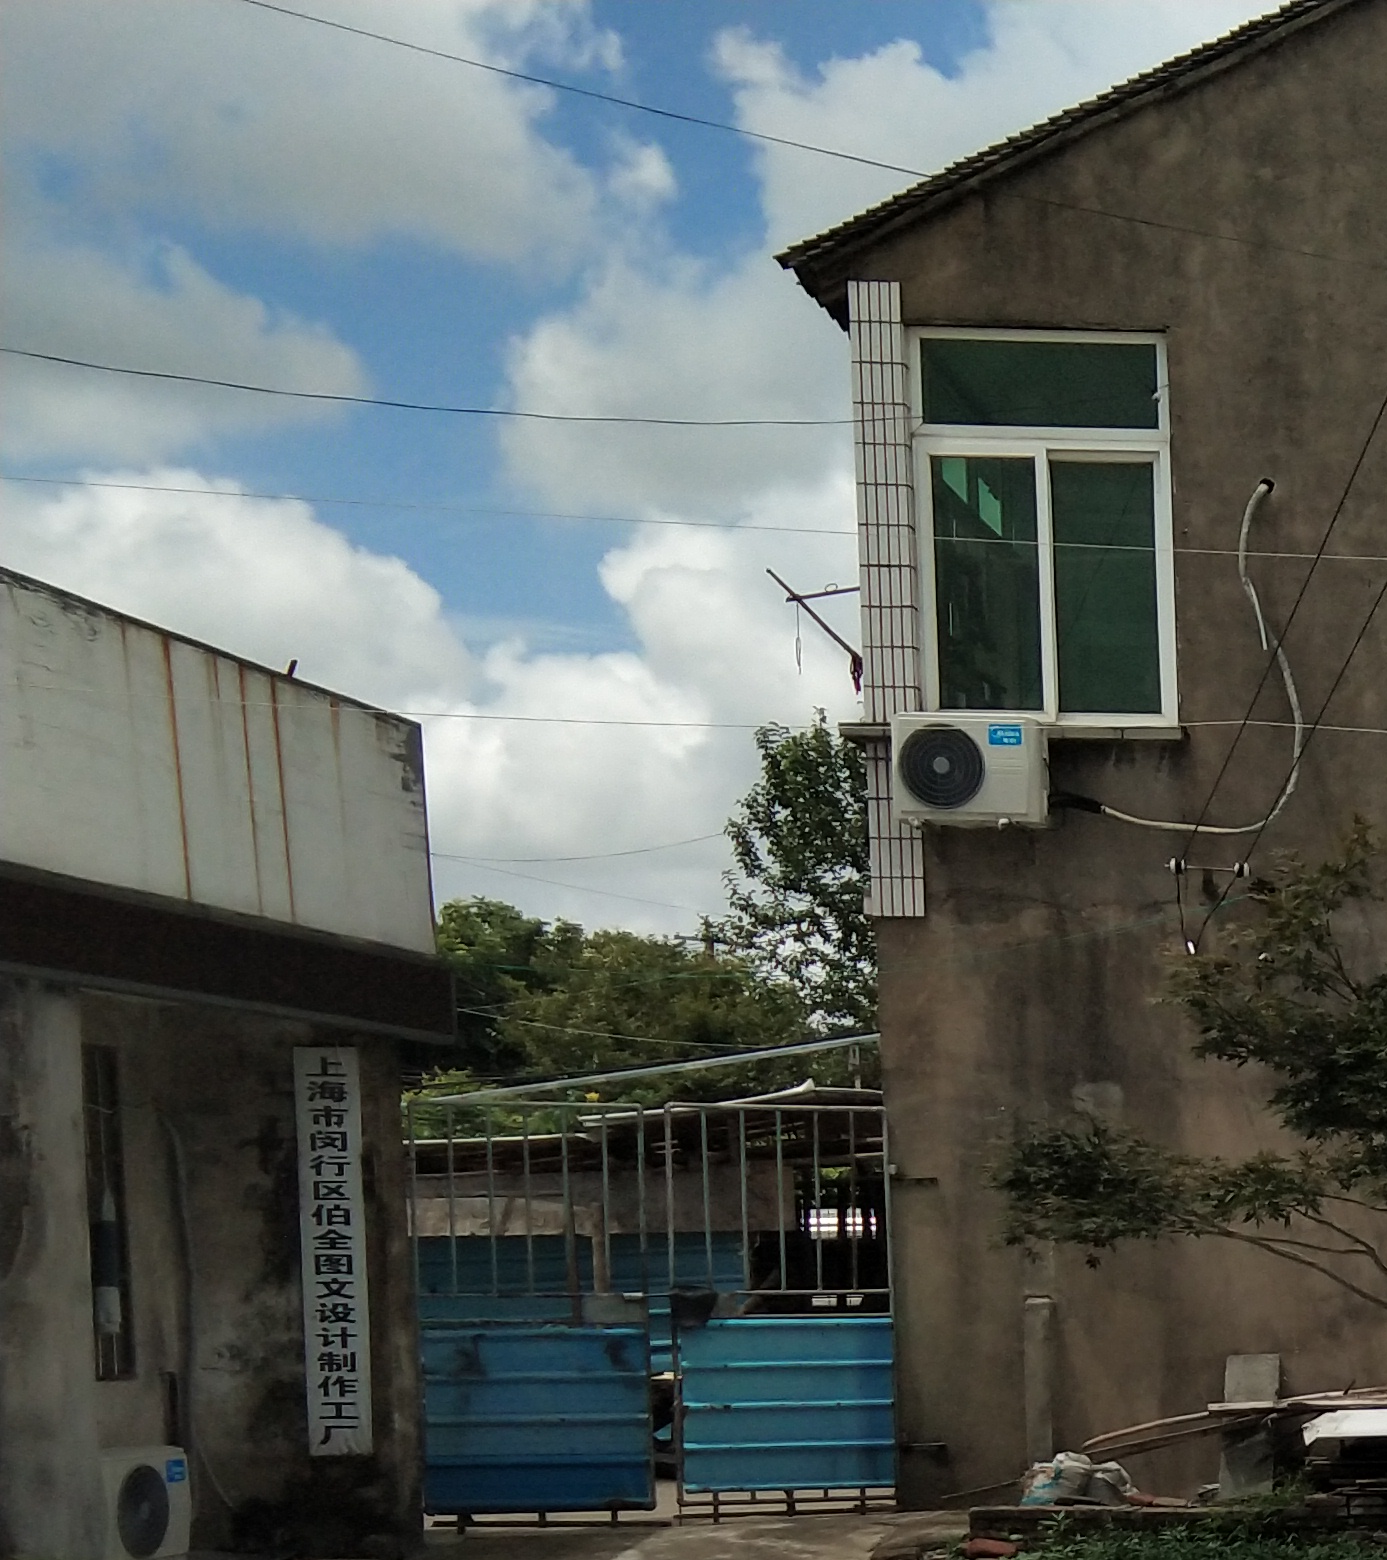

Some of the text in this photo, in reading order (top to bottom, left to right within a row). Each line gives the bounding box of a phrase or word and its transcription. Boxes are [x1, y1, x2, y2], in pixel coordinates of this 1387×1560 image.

[307, 1055, 360, 1446] 上海市闵行区伯全图文设计制作工厂
